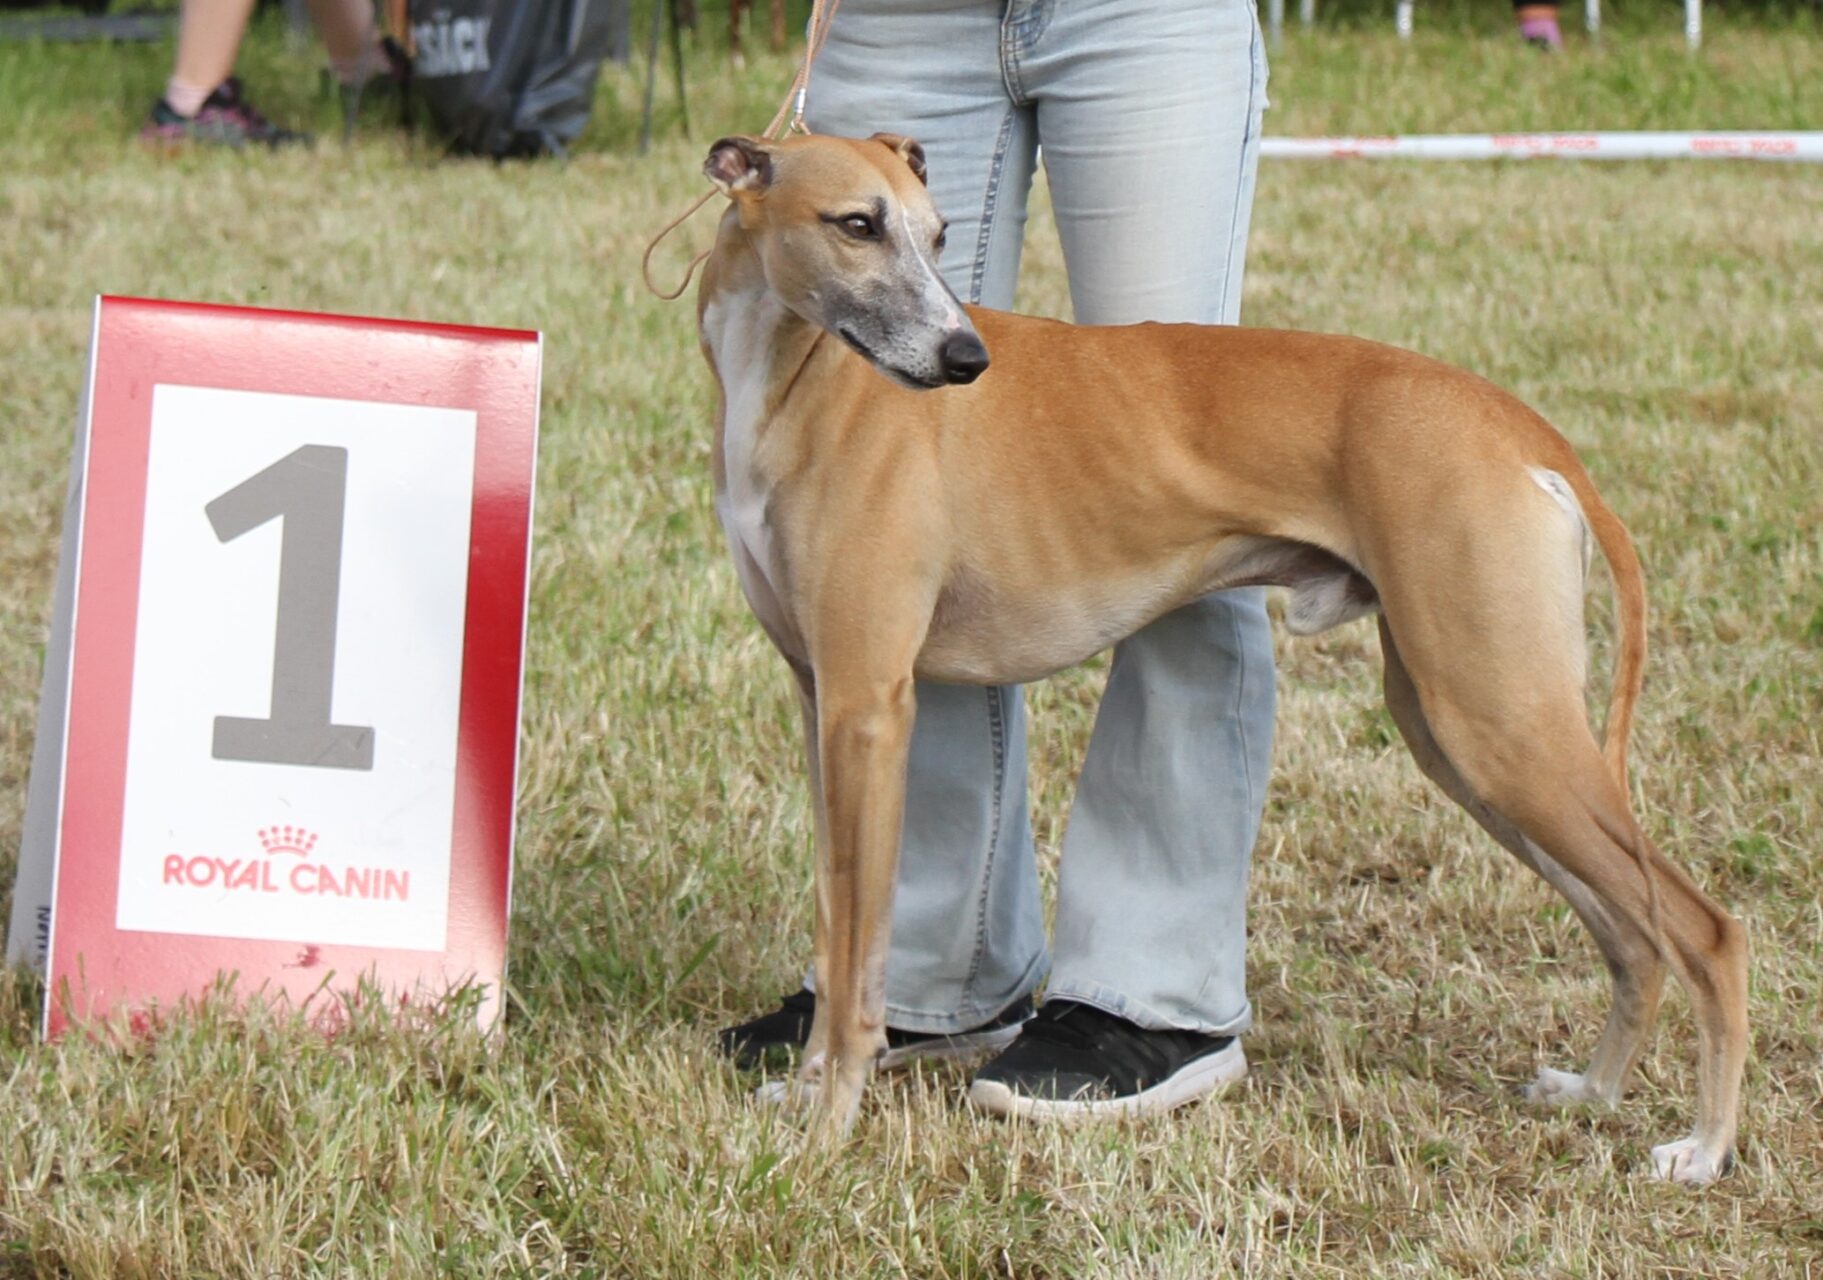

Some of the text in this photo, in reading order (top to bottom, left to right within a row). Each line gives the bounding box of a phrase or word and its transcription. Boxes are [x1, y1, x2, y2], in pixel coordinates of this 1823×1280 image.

[205, 443, 375, 772] 1
[163, 854, 410, 902] ROYAL CANIN
